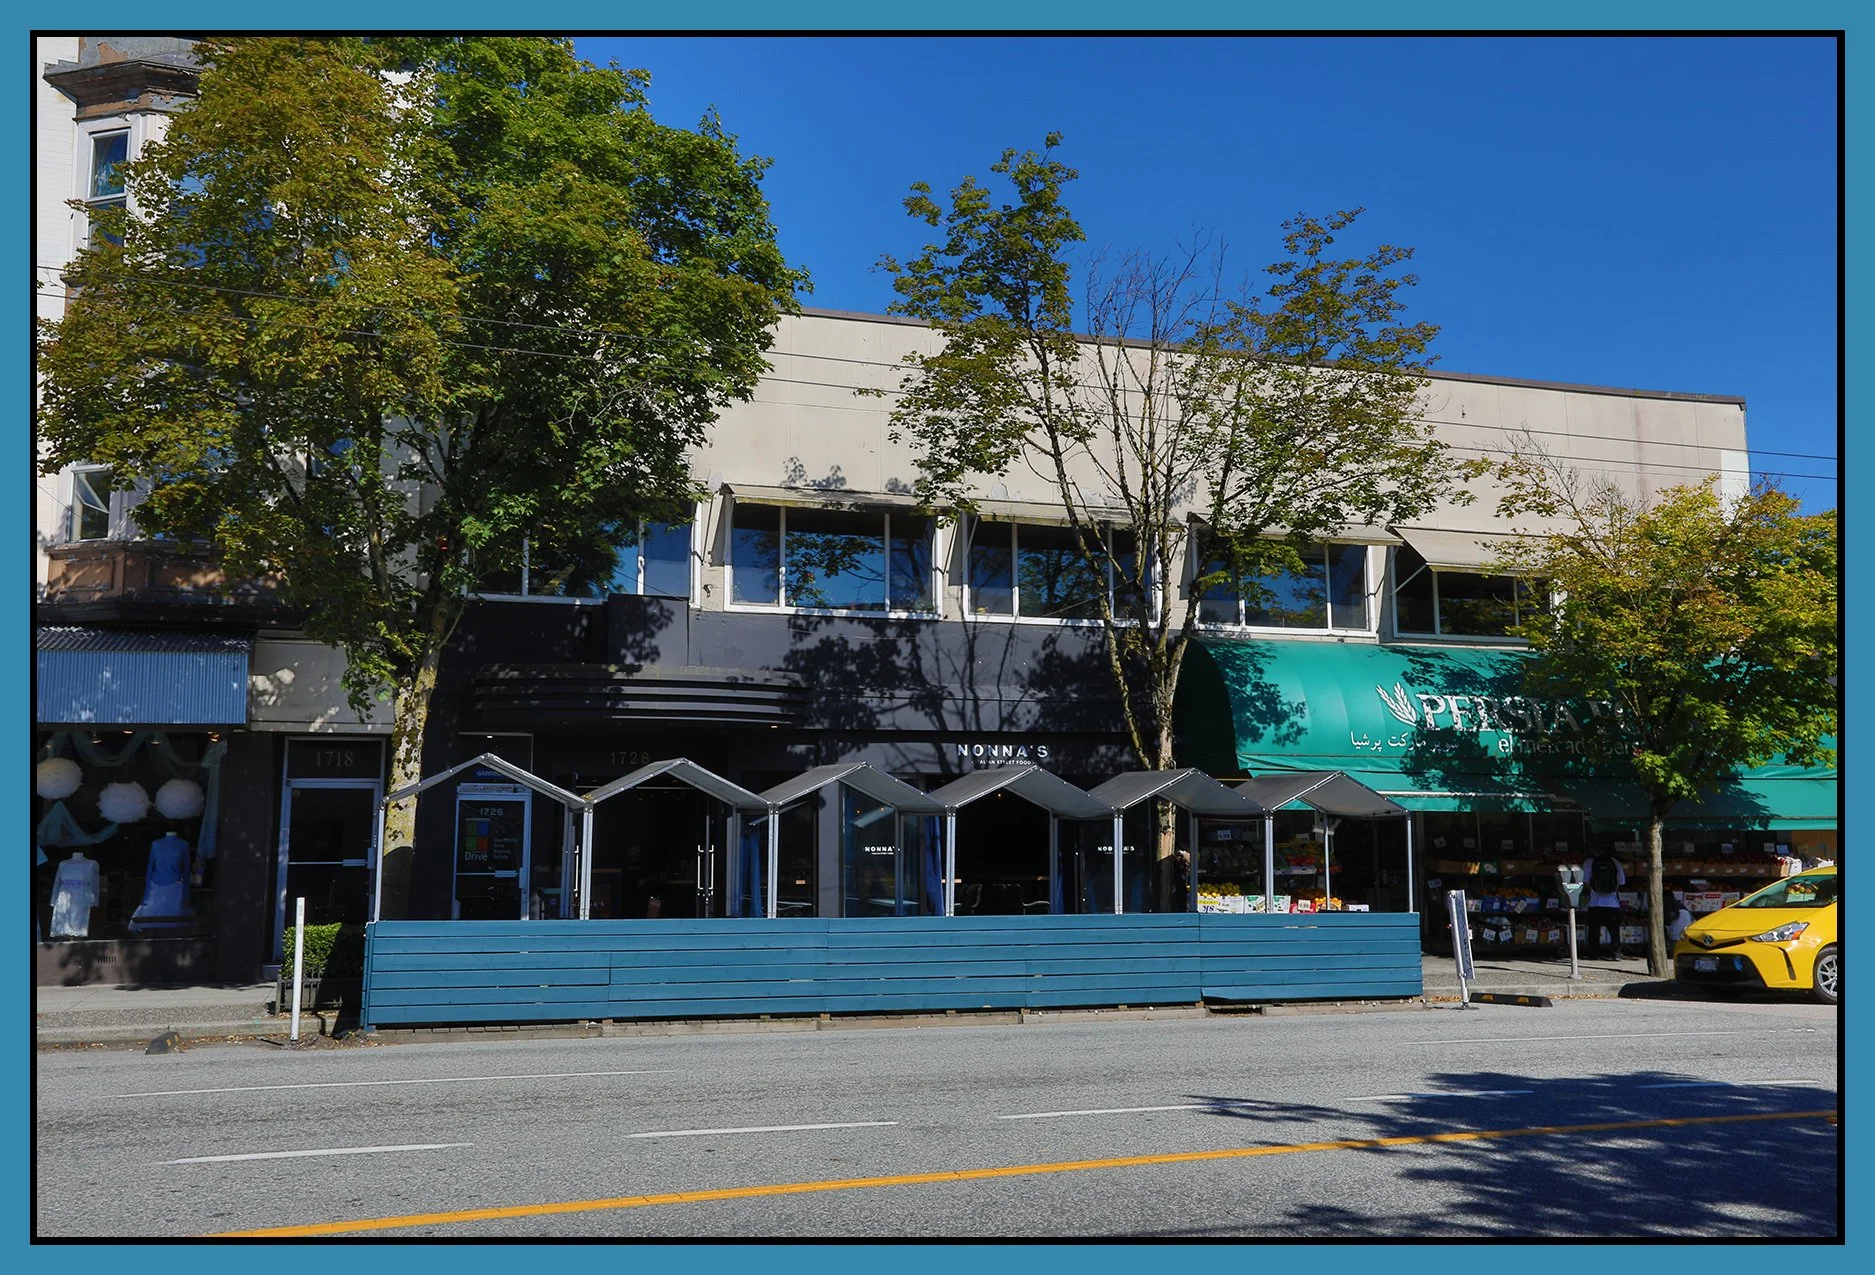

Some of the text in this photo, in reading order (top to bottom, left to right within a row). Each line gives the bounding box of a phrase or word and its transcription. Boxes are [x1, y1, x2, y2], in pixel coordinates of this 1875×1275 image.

[1415, 694, 1583, 735] PERSIA
[1350, 730, 1382, 752] پرشیا
[1517, 737, 1598, 756] mercad
[610, 751, 651, 766] 1728
[957, 743, 1049, 758] NONNA'S
[315, 750, 354, 768] 1718
[480, 808, 504, 816] 1726
[464, 852, 488, 861] Drive
